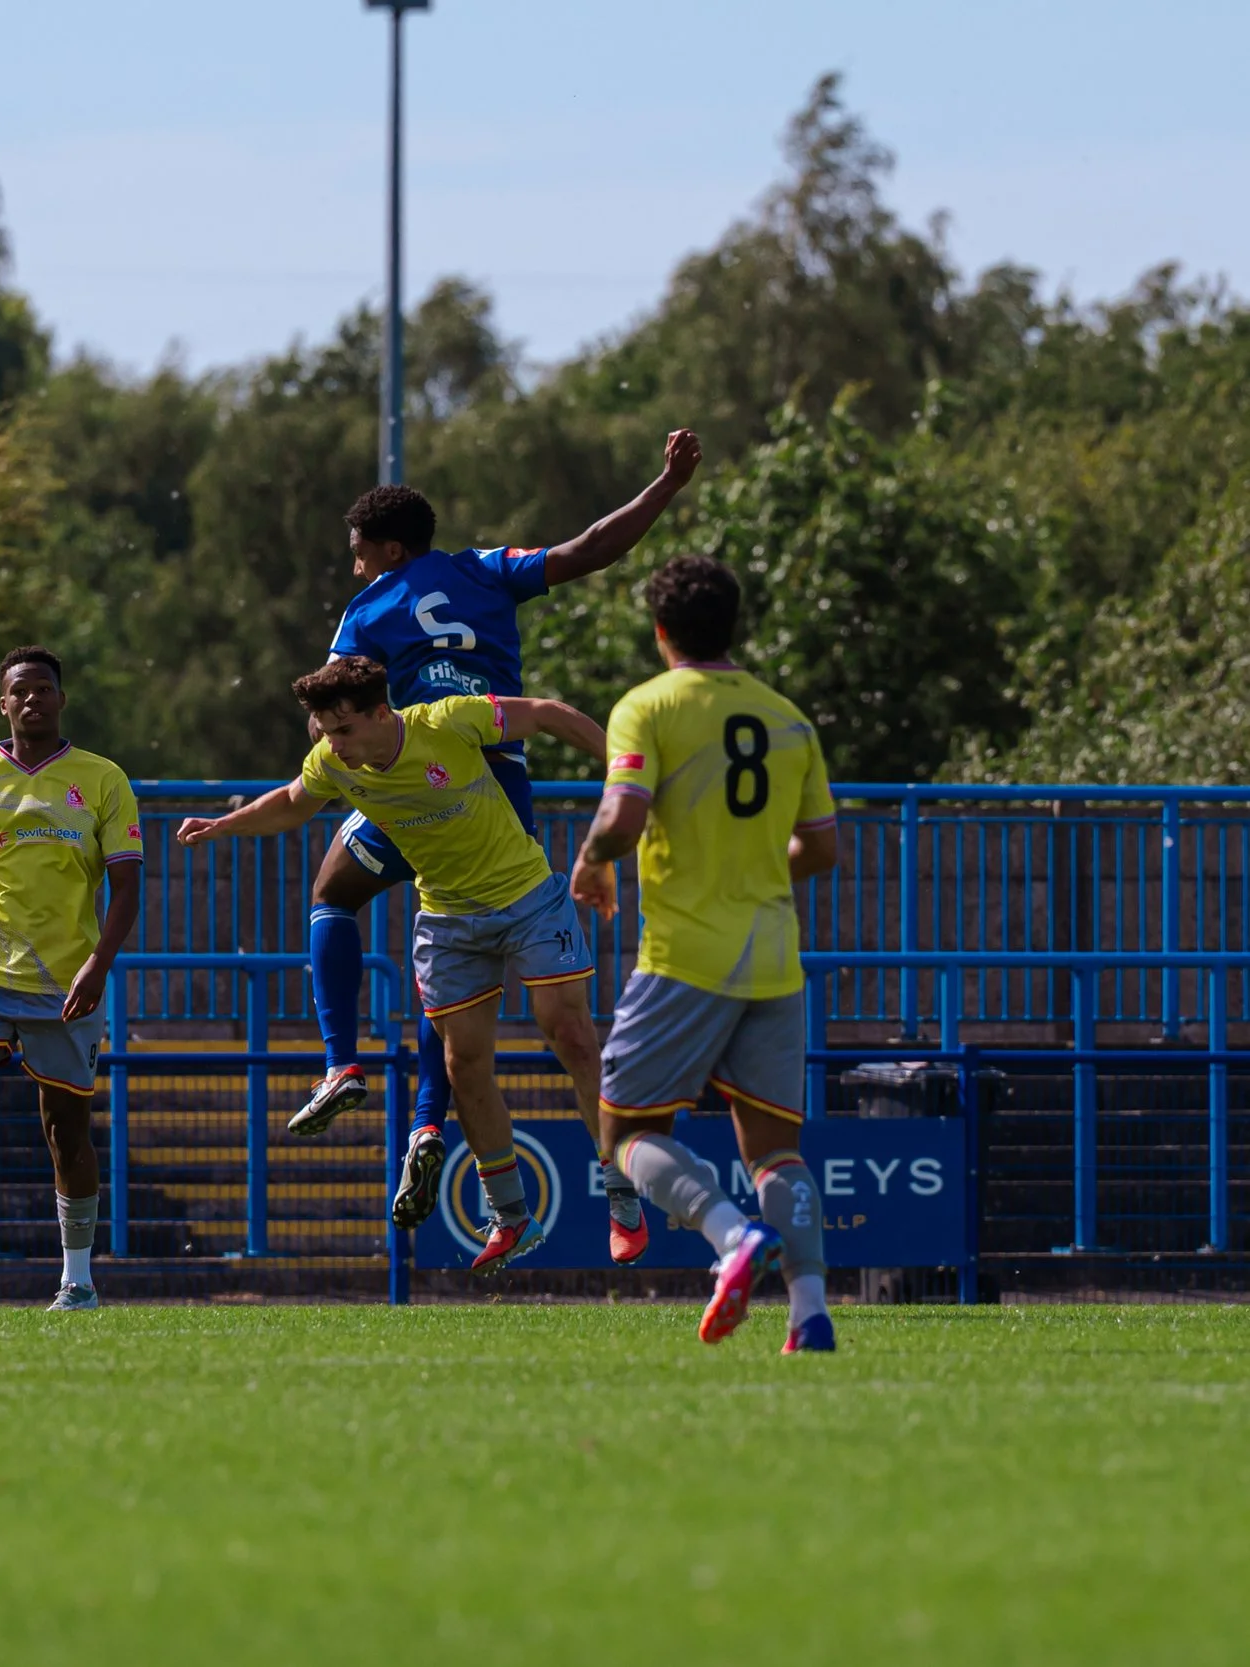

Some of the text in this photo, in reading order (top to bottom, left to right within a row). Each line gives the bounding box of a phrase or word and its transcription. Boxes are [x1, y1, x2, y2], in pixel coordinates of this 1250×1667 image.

[724, 713, 769, 818] 8
[395, 800, 466, 829] Switchgear
[16, 826, 83, 841] Switchgear
[554, 928, 574, 952] 11
[89, 1043, 97, 1069] 9
[823, 1214, 867, 1230] LLP
